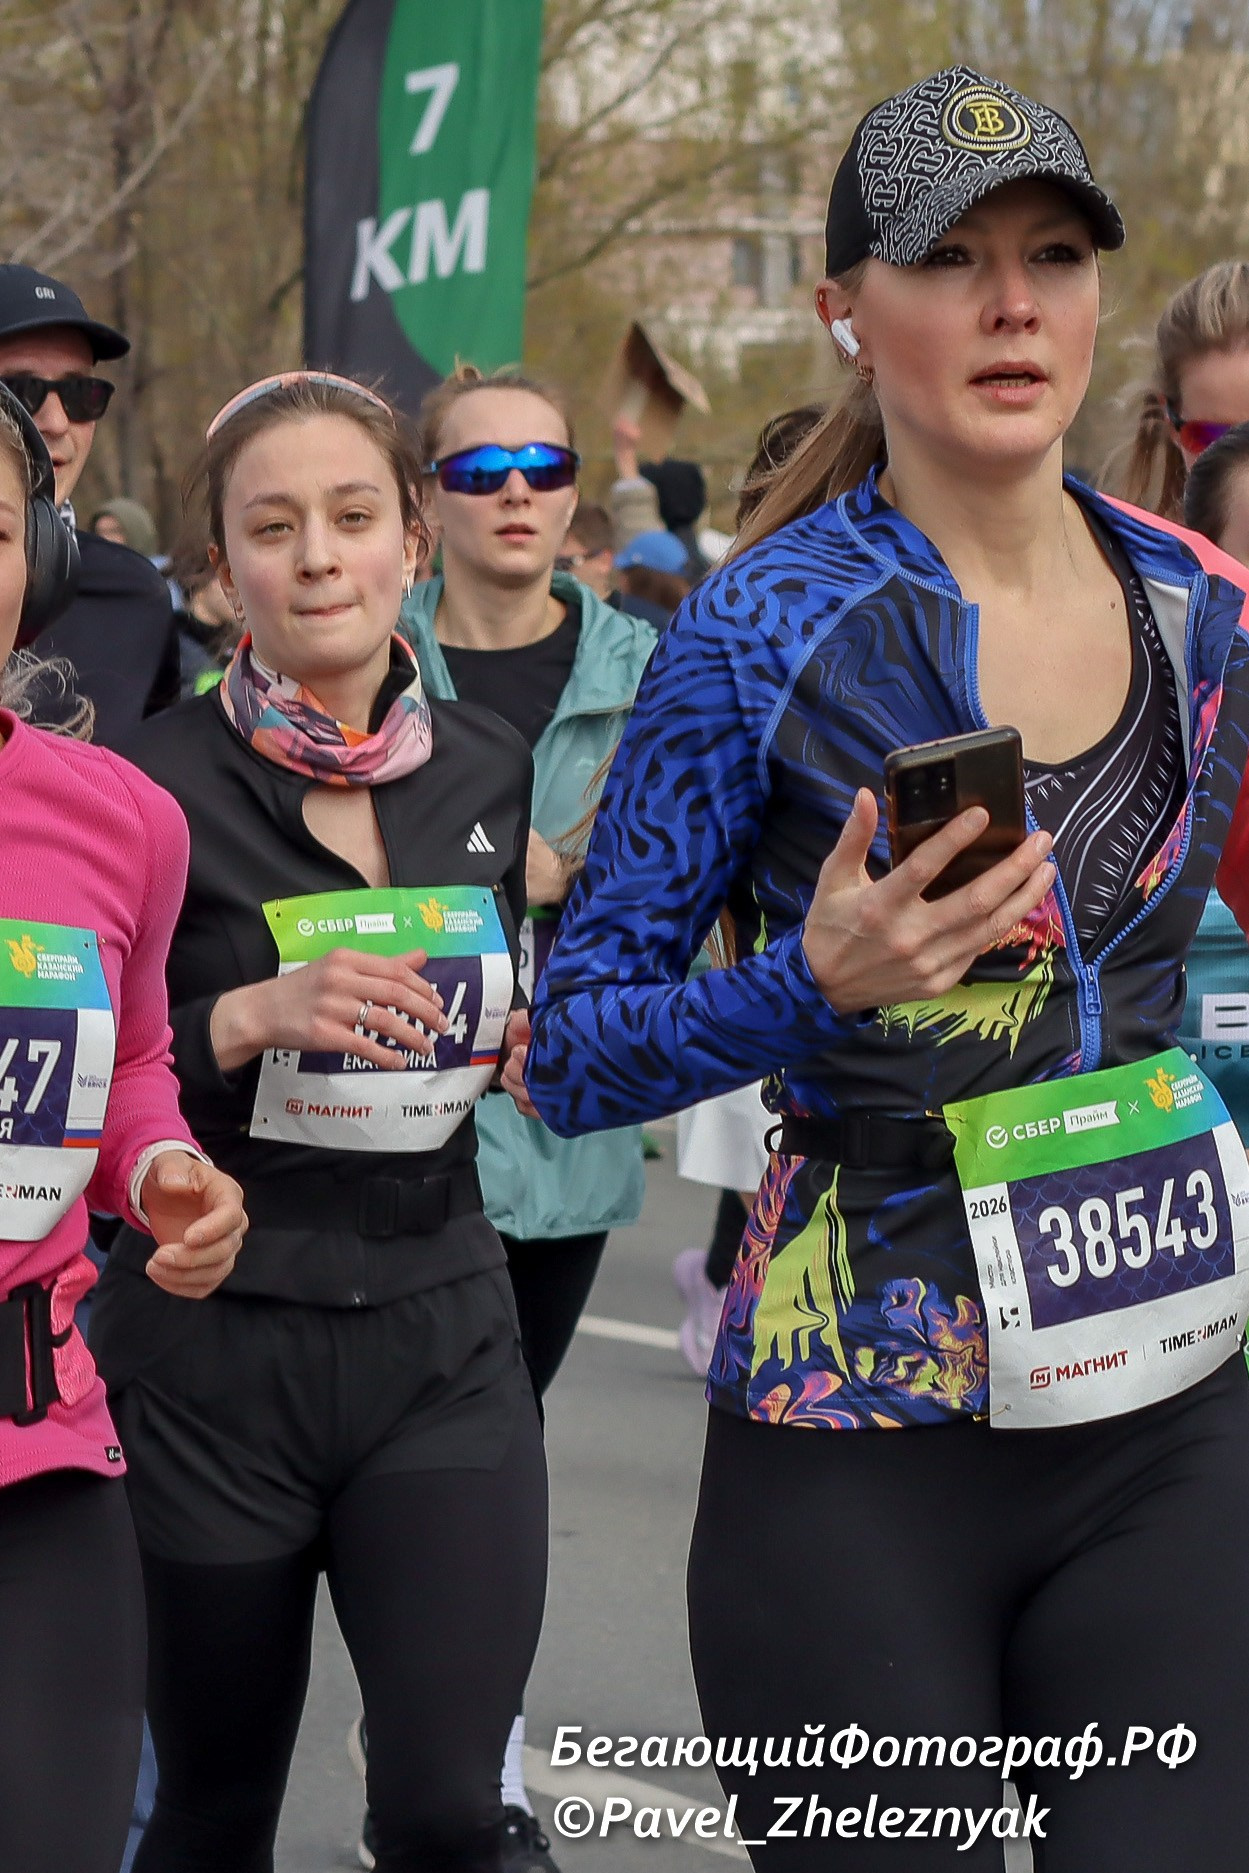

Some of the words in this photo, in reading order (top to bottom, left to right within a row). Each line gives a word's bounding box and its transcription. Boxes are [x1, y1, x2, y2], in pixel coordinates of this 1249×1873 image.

[405, 62, 460, 155] 7
[307, 1103, 373, 1119] МАГНИТ
[1012, 1116, 1061, 1141] СБЕР
[1069, 1109, 1109, 1127] Прайм
[969, 1195, 1008, 1220] 2026
[1038, 1168, 1219, 1289] 38543
[1055, 1350, 1129, 1382] МАГНИТ
